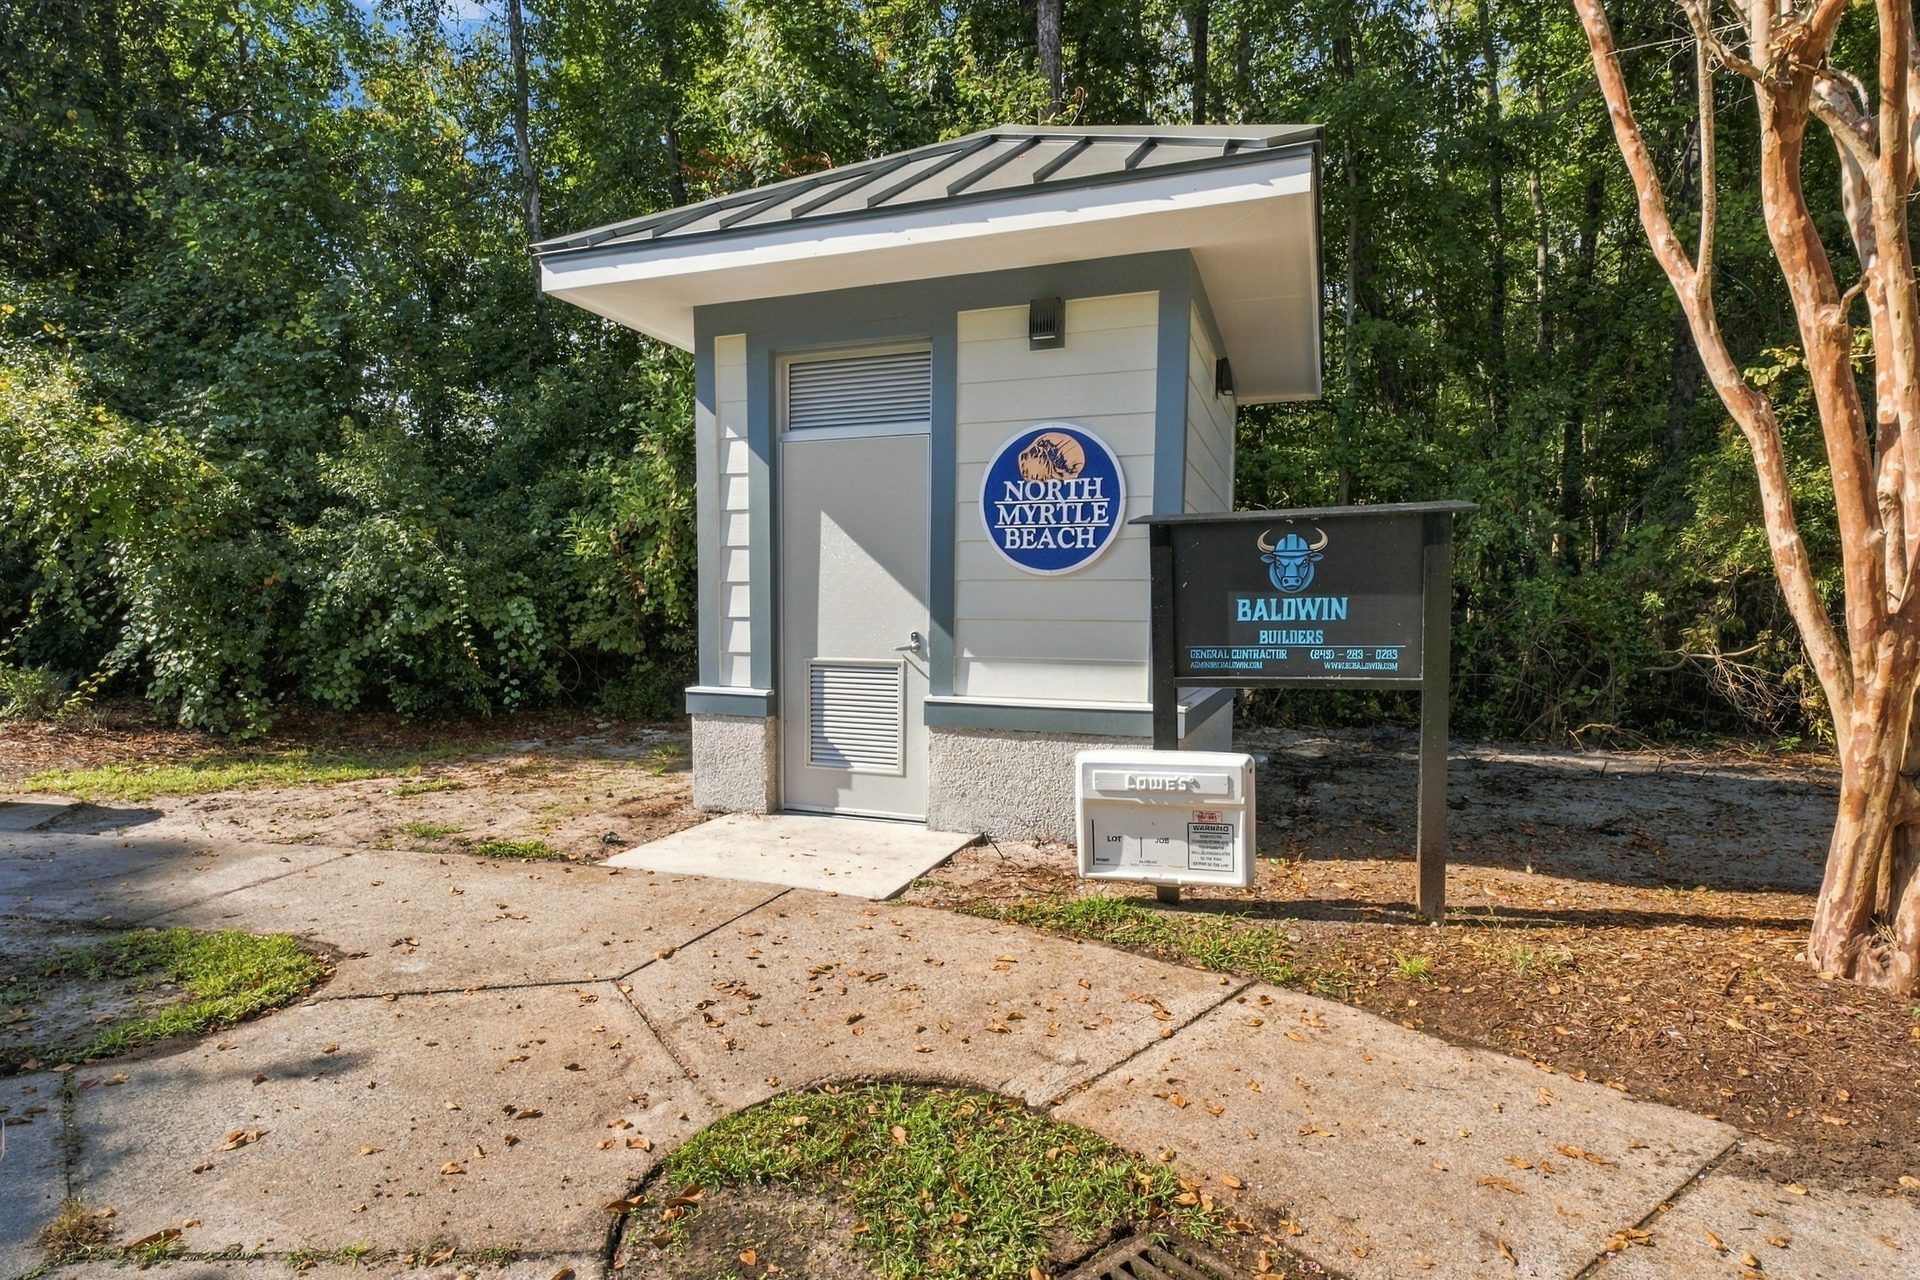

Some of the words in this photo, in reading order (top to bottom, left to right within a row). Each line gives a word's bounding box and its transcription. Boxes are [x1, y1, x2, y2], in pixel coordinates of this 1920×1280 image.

[1003, 477, 1104, 501] NORTH
[996, 502, 1109, 525] MYRTLE
[1004, 527, 1096, 549] BEACH
[1236, 597, 1348, 621] BALDWIN
[1259, 630, 1324, 644] BUILDERS
[1190, 649, 1230, 659] GENERAL
[1231, 649, 1288, 659] CONTRACTOR
[1107, 835, 1122, 843] LOT
